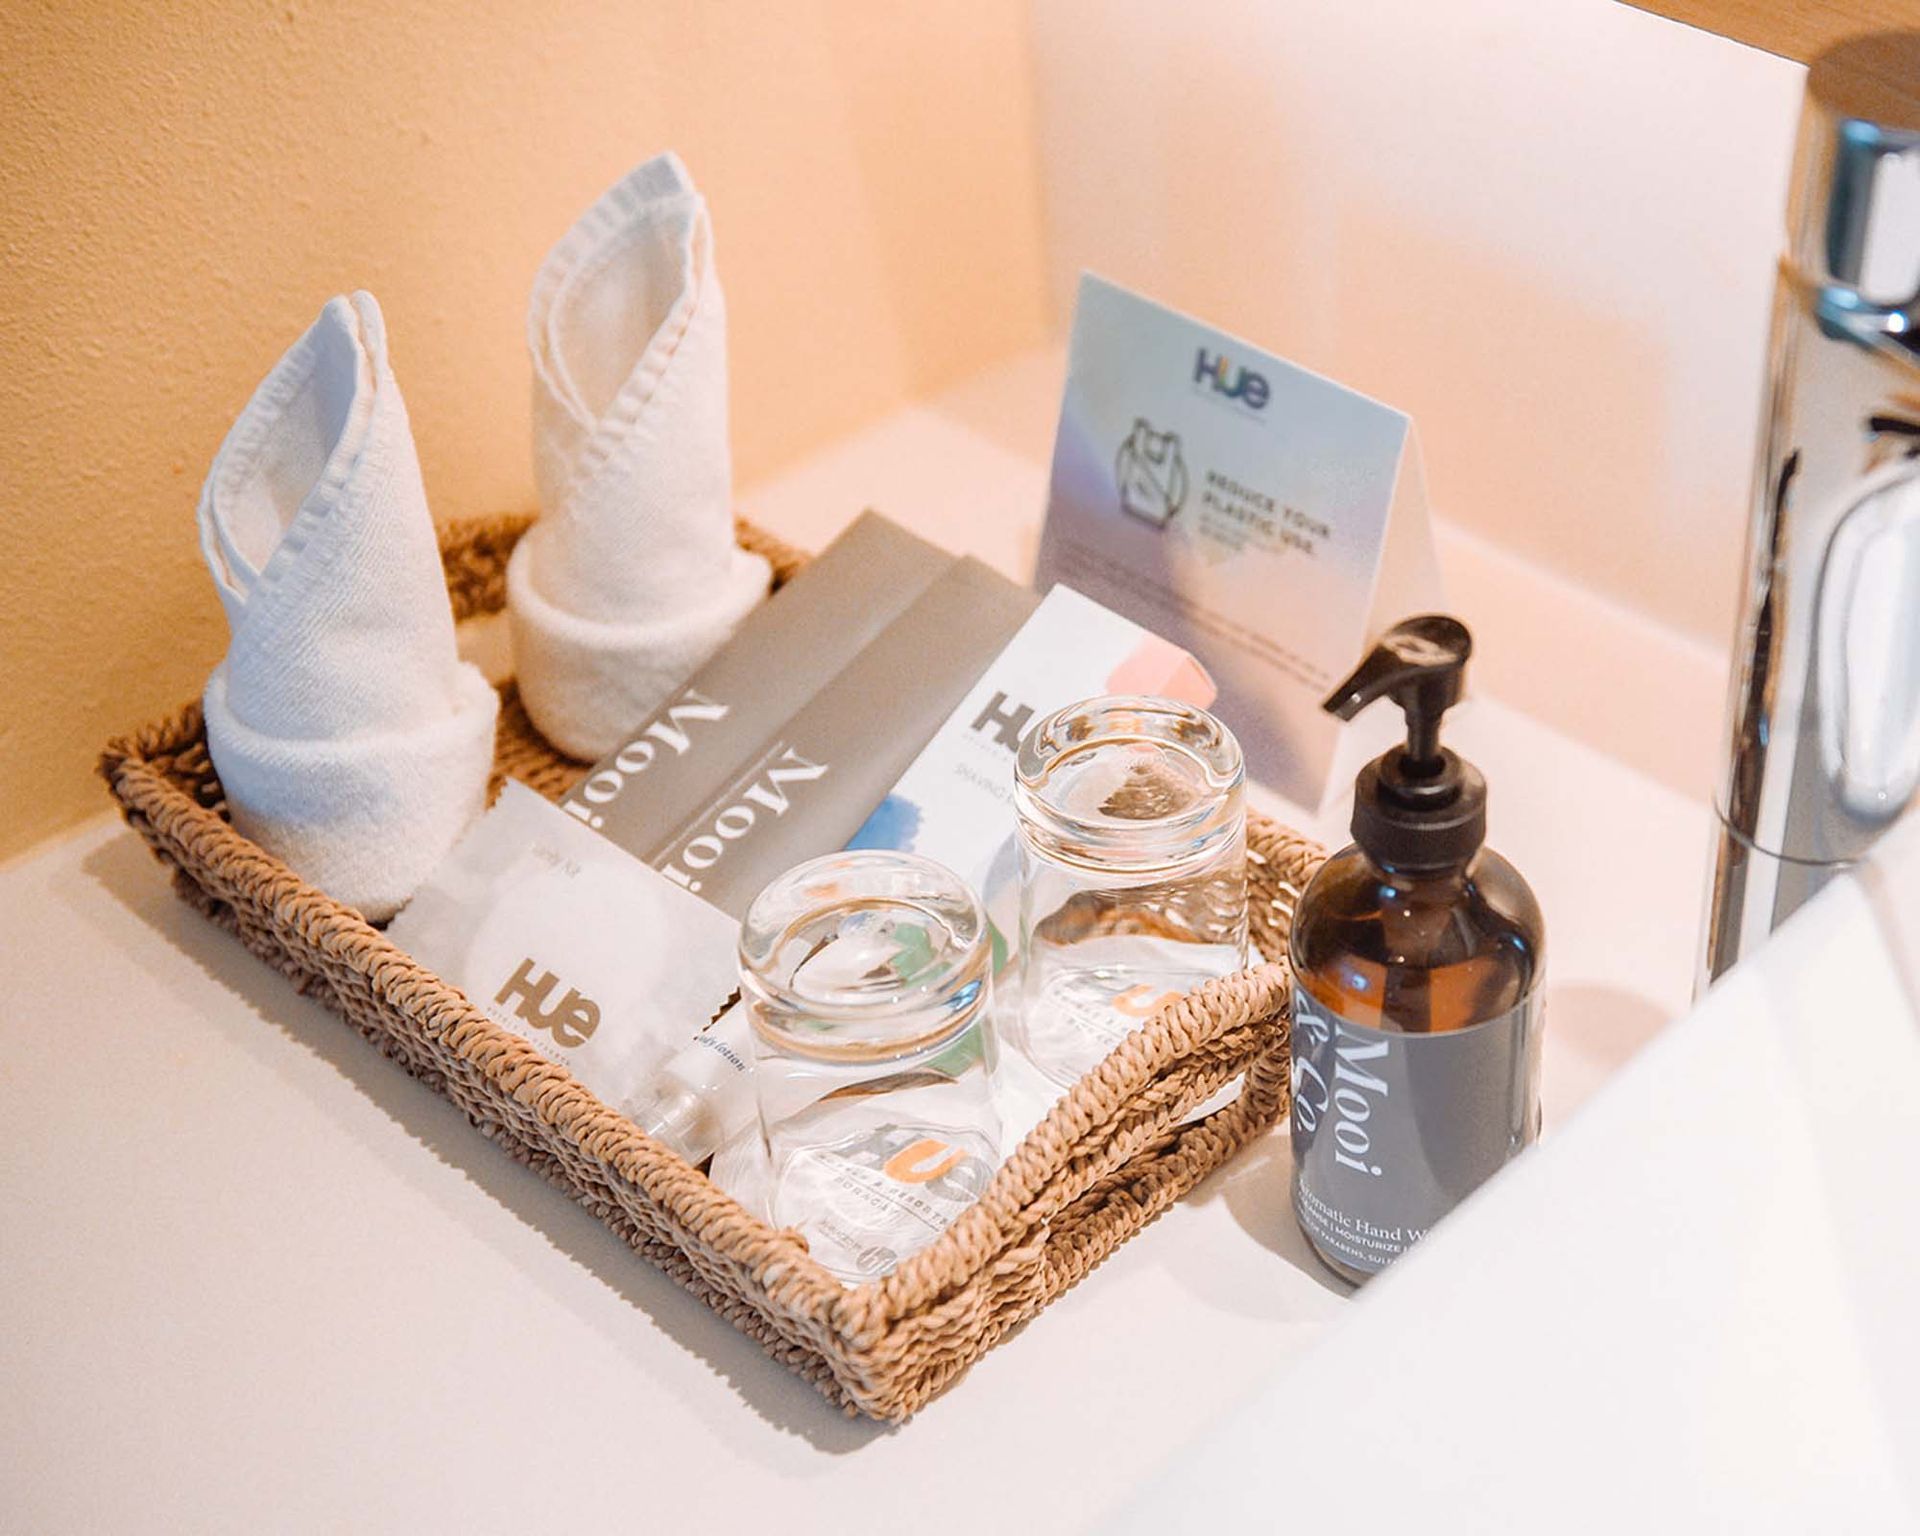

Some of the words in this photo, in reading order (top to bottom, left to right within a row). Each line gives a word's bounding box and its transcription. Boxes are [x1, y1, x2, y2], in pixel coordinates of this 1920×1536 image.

[563, 689, 730, 829] Mooi
[660, 748, 829, 892] Mooi
[714, 1042, 746, 1072] lotion
[1334, 1022, 1389, 1177] Mooi
[1334, 1225, 1401, 1254] MOISTURIZE
[1355, 1218, 1402, 1241] Hand
